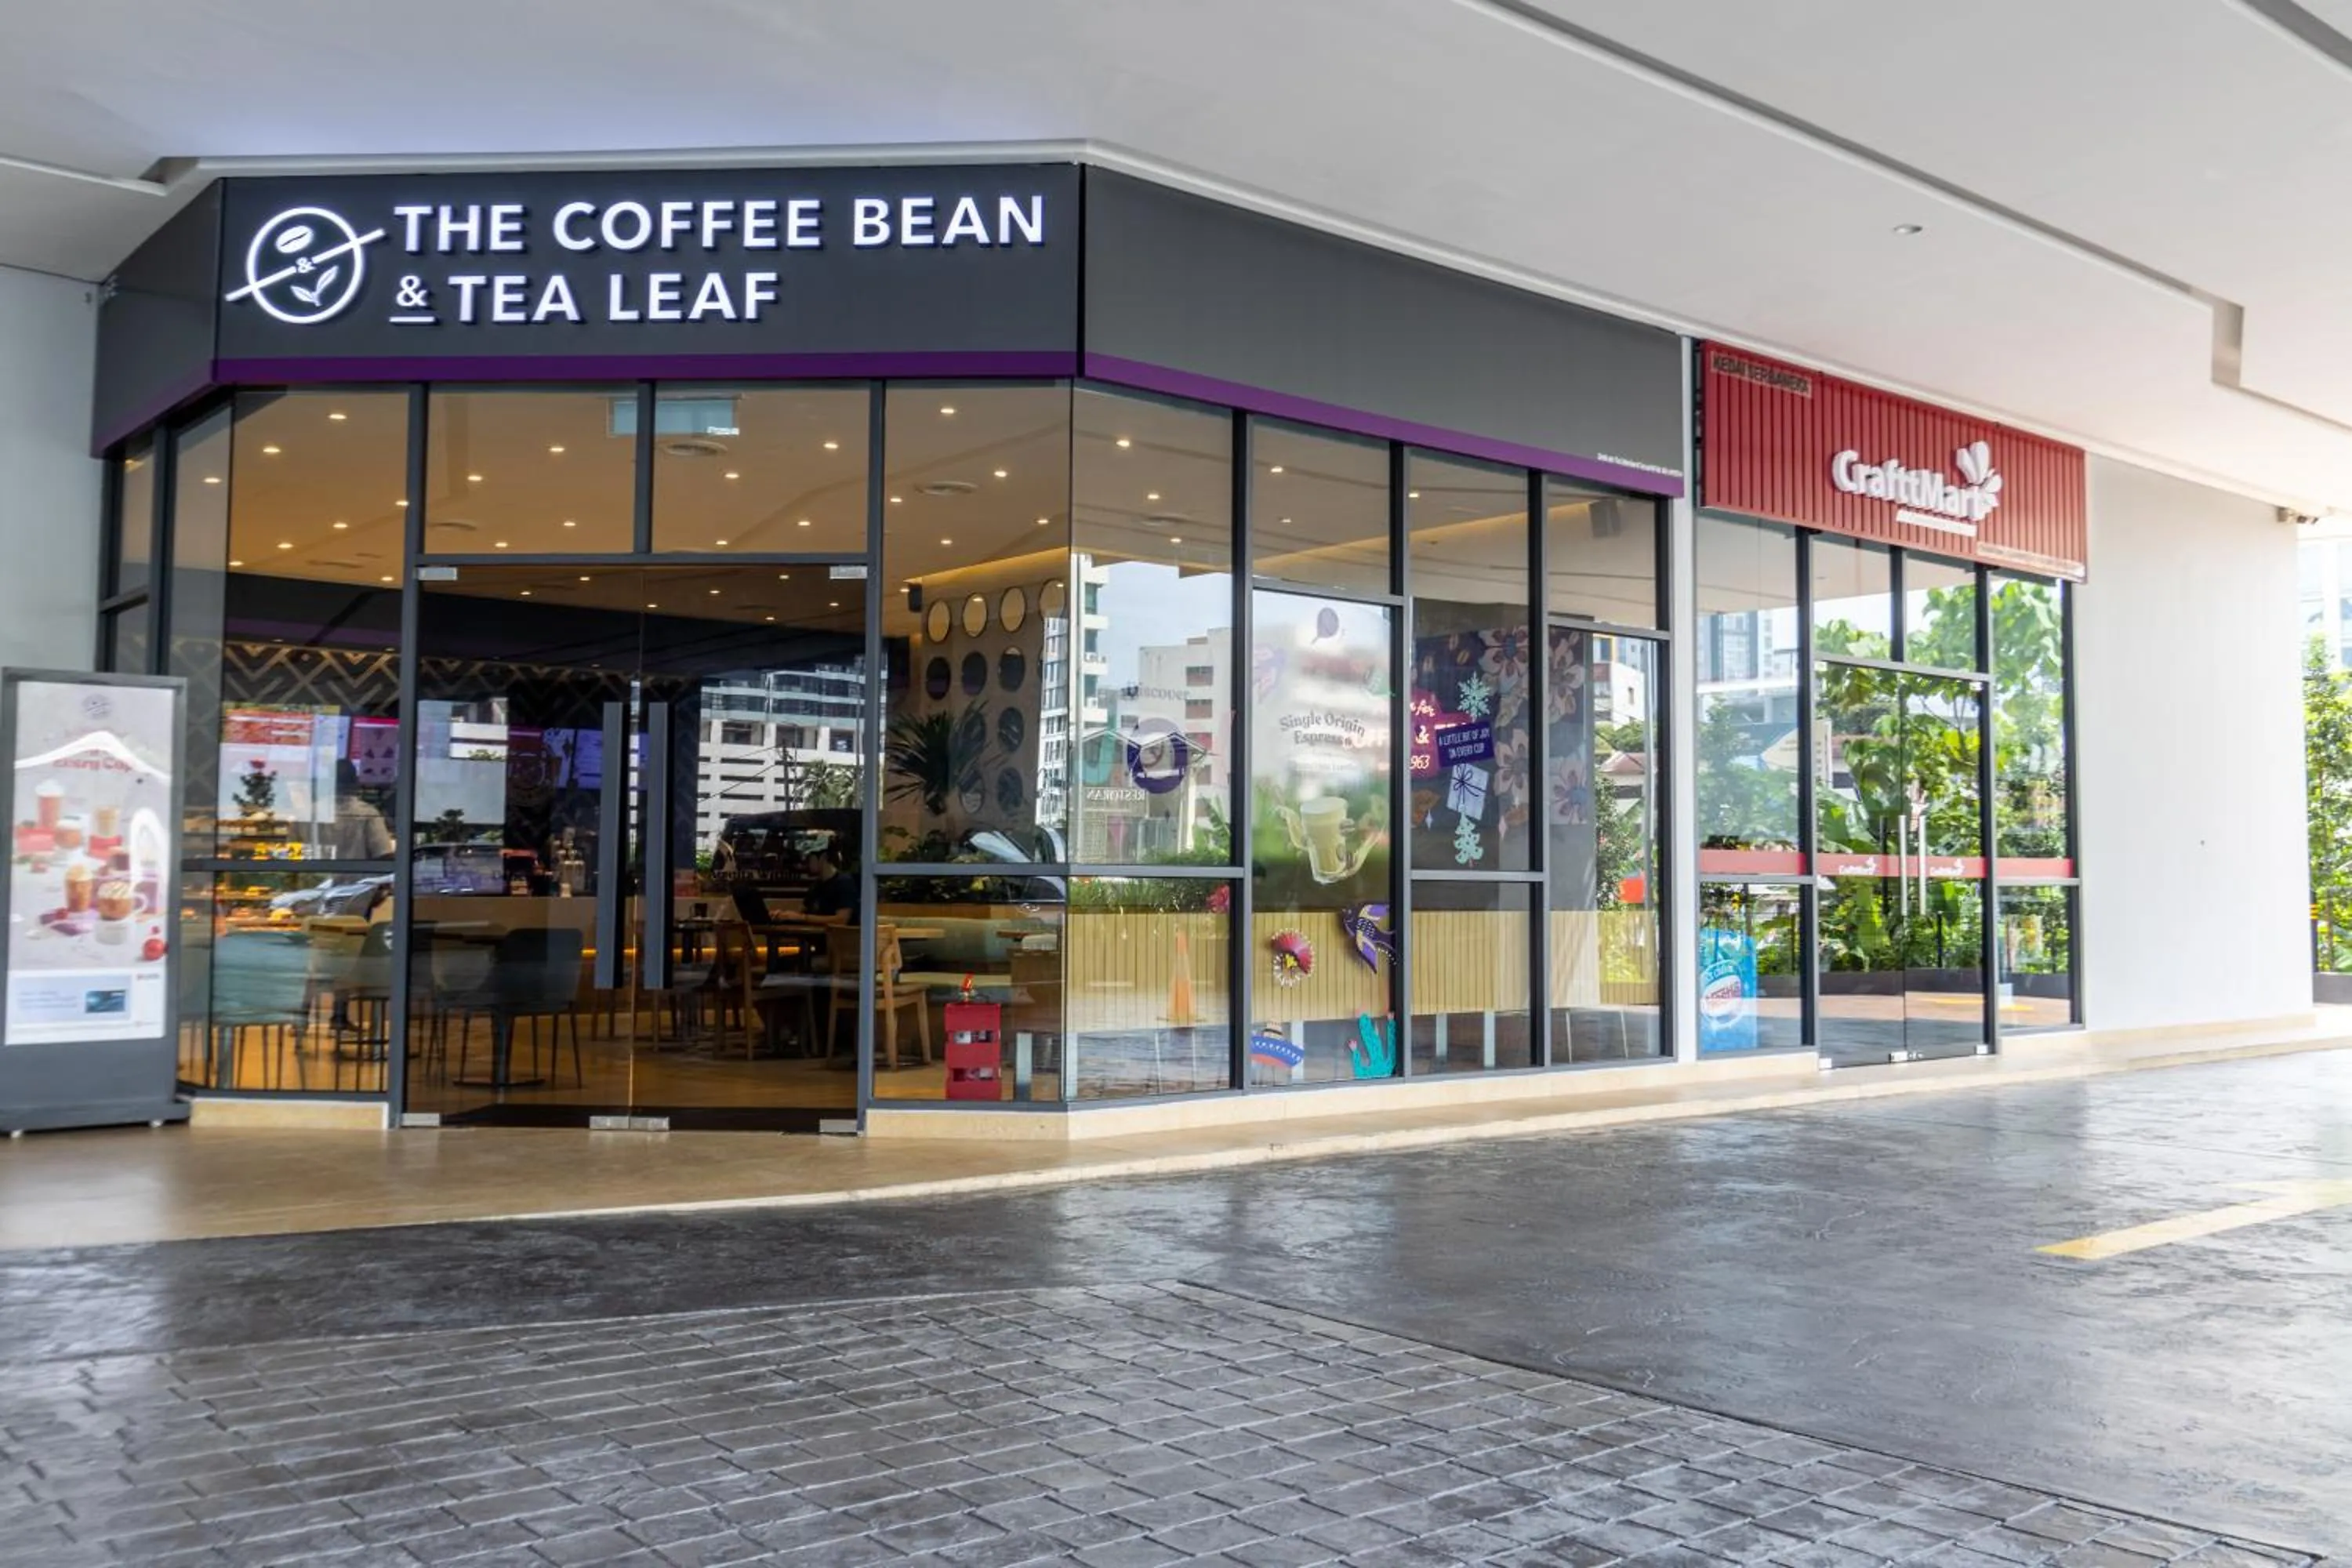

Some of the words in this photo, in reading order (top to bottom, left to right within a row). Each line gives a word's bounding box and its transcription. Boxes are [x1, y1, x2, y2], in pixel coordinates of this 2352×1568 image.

[394, 204, 524, 252] THE
[553, 200, 821, 251] COFFEE
[853, 195, 1044, 246] BEAN
[296, 256, 317, 273] &
[448, 274, 580, 322] TEA
[608, 271, 779, 321] LEAF
[1279, 709, 1322, 731] Single
[1323, 711, 1366, 738] Origin
